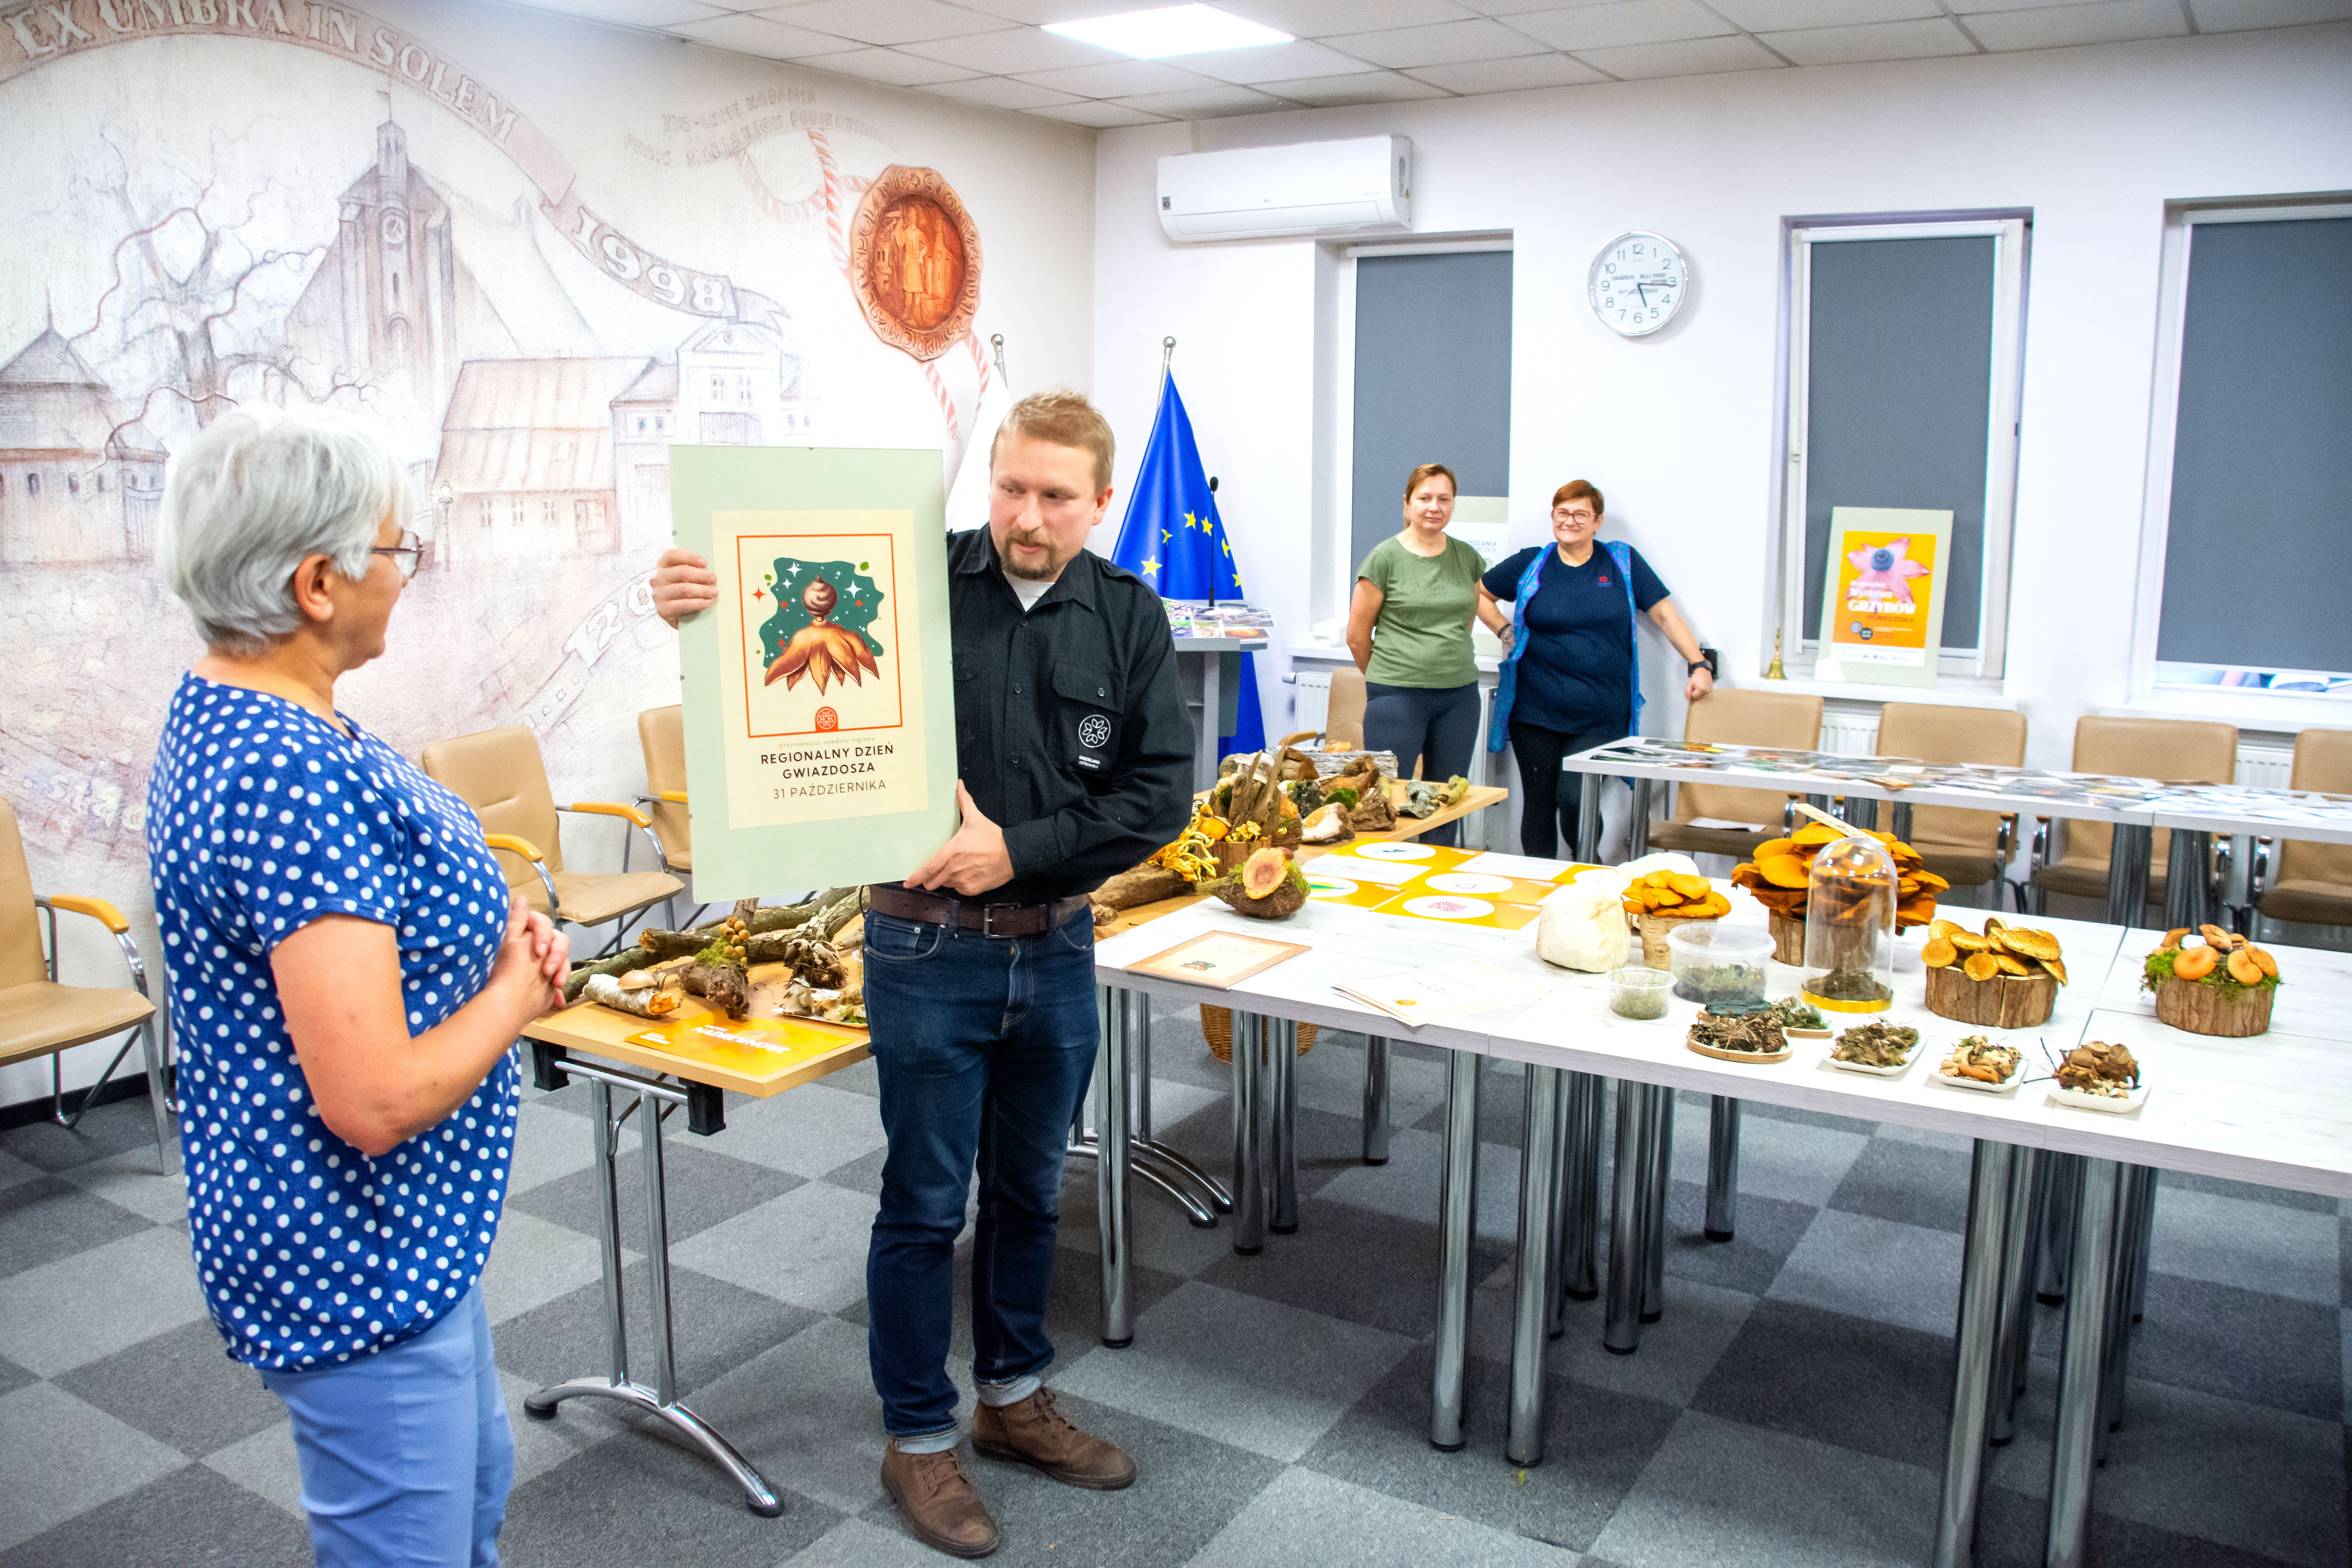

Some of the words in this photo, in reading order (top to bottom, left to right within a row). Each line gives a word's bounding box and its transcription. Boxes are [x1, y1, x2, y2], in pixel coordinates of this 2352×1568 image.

[2, 0, 95, 58] EX
[305, 1, 358, 53] IN
[369, 27, 519, 143] SOLEM
[1633, 243, 1644, 254] 12
[1653, 247, 1657, 258] 1
[571, 206, 725, 313] 1998
[1617, 249, 1625, 260] 11
[1605, 263, 1616, 274] 10
[1662, 258, 1671, 269] 2
[1601, 280, 1610, 291] 9
[1669, 277, 1677, 288] 3
[1606, 297, 1614, 308] 8
[1661, 294, 1671, 305] 4
[1619, 309, 1626, 320] 7
[1634, 312, 1643, 323] 6
[1650, 307, 1659, 318] 5
[1868, 614, 1914, 622] POBIEDZISKA
[779, 740, 822, 750] przyrodnicze
[823, 737, 849, 746] symbole
[851, 736, 875, 745] regionu
[761, 748, 850, 764] REGIONALNY
[855, 742, 894, 757] DZIEŃ
[783, 762, 875, 779] GWIAZDOSZA
[773, 789, 785, 799] 31
[790, 779, 886, 798] PAŹDZIERNIKA
